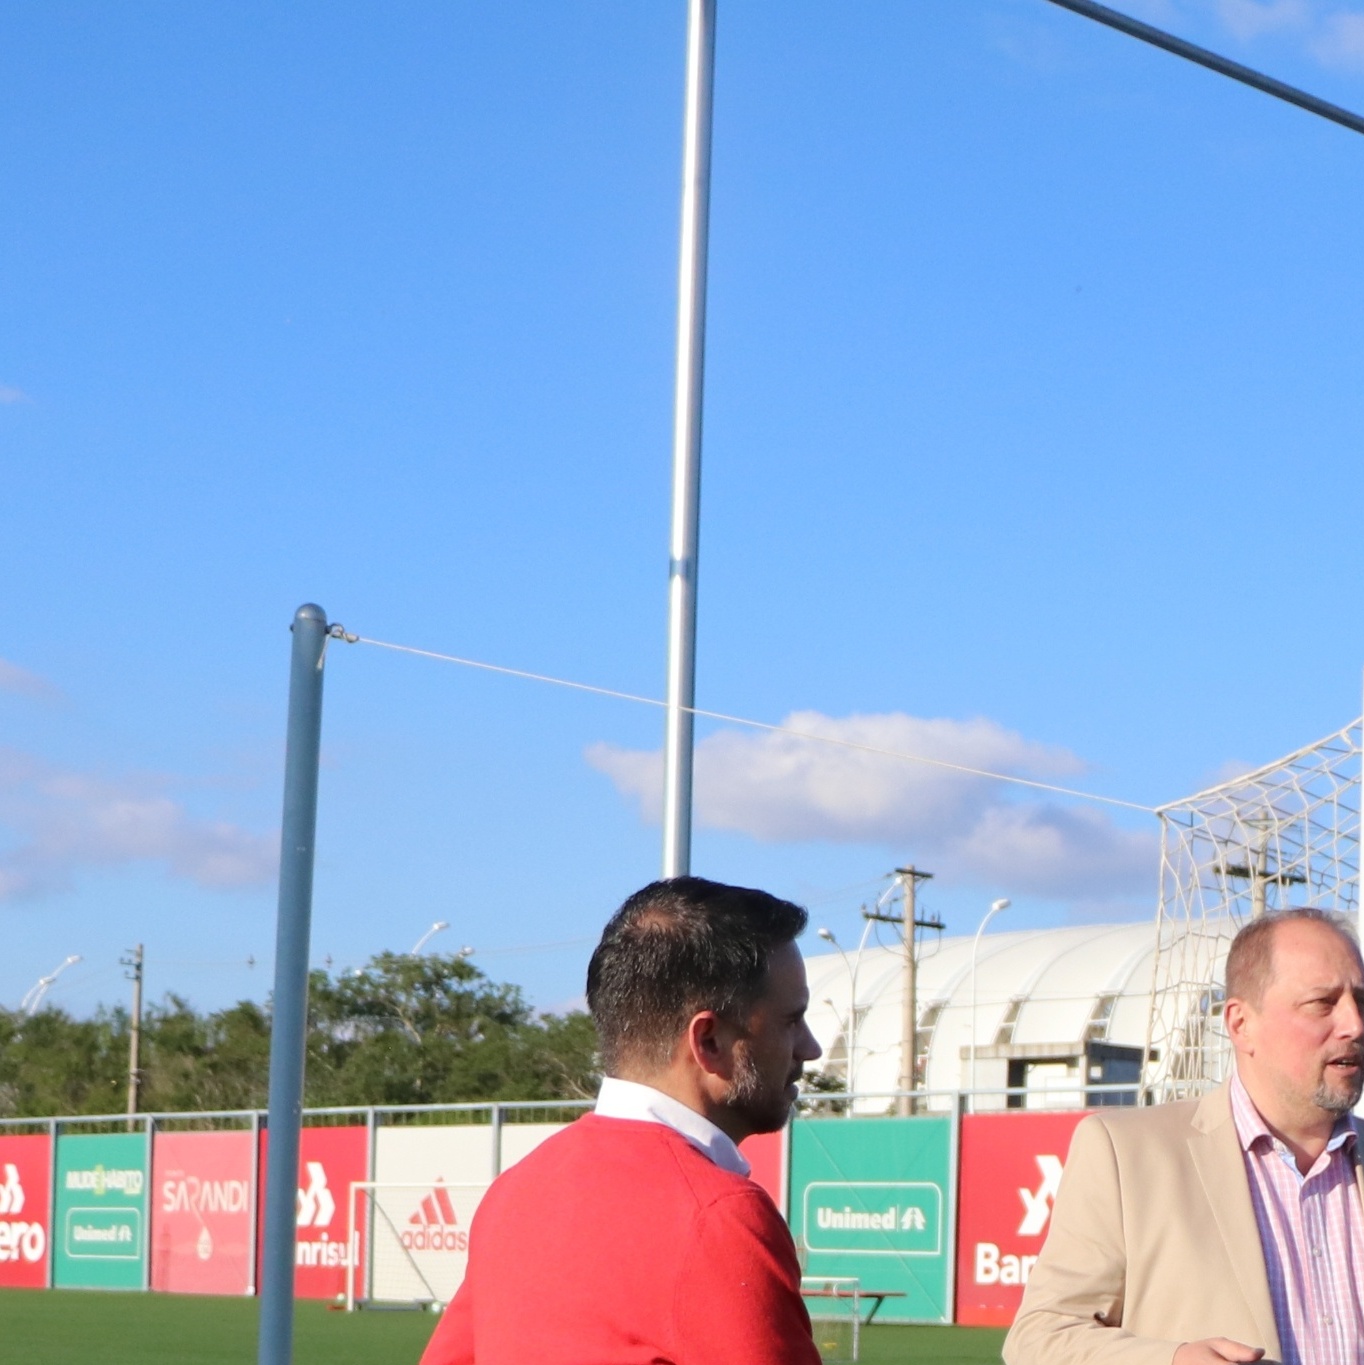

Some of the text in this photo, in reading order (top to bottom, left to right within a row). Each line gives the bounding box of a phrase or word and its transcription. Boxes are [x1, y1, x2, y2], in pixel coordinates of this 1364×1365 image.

[163, 1176, 249, 1213] SARANDI
[816, 1206, 896, 1231] Unimed
[296, 1231, 361, 1267] nrisul
[402, 1224, 468, 1251] adidas
